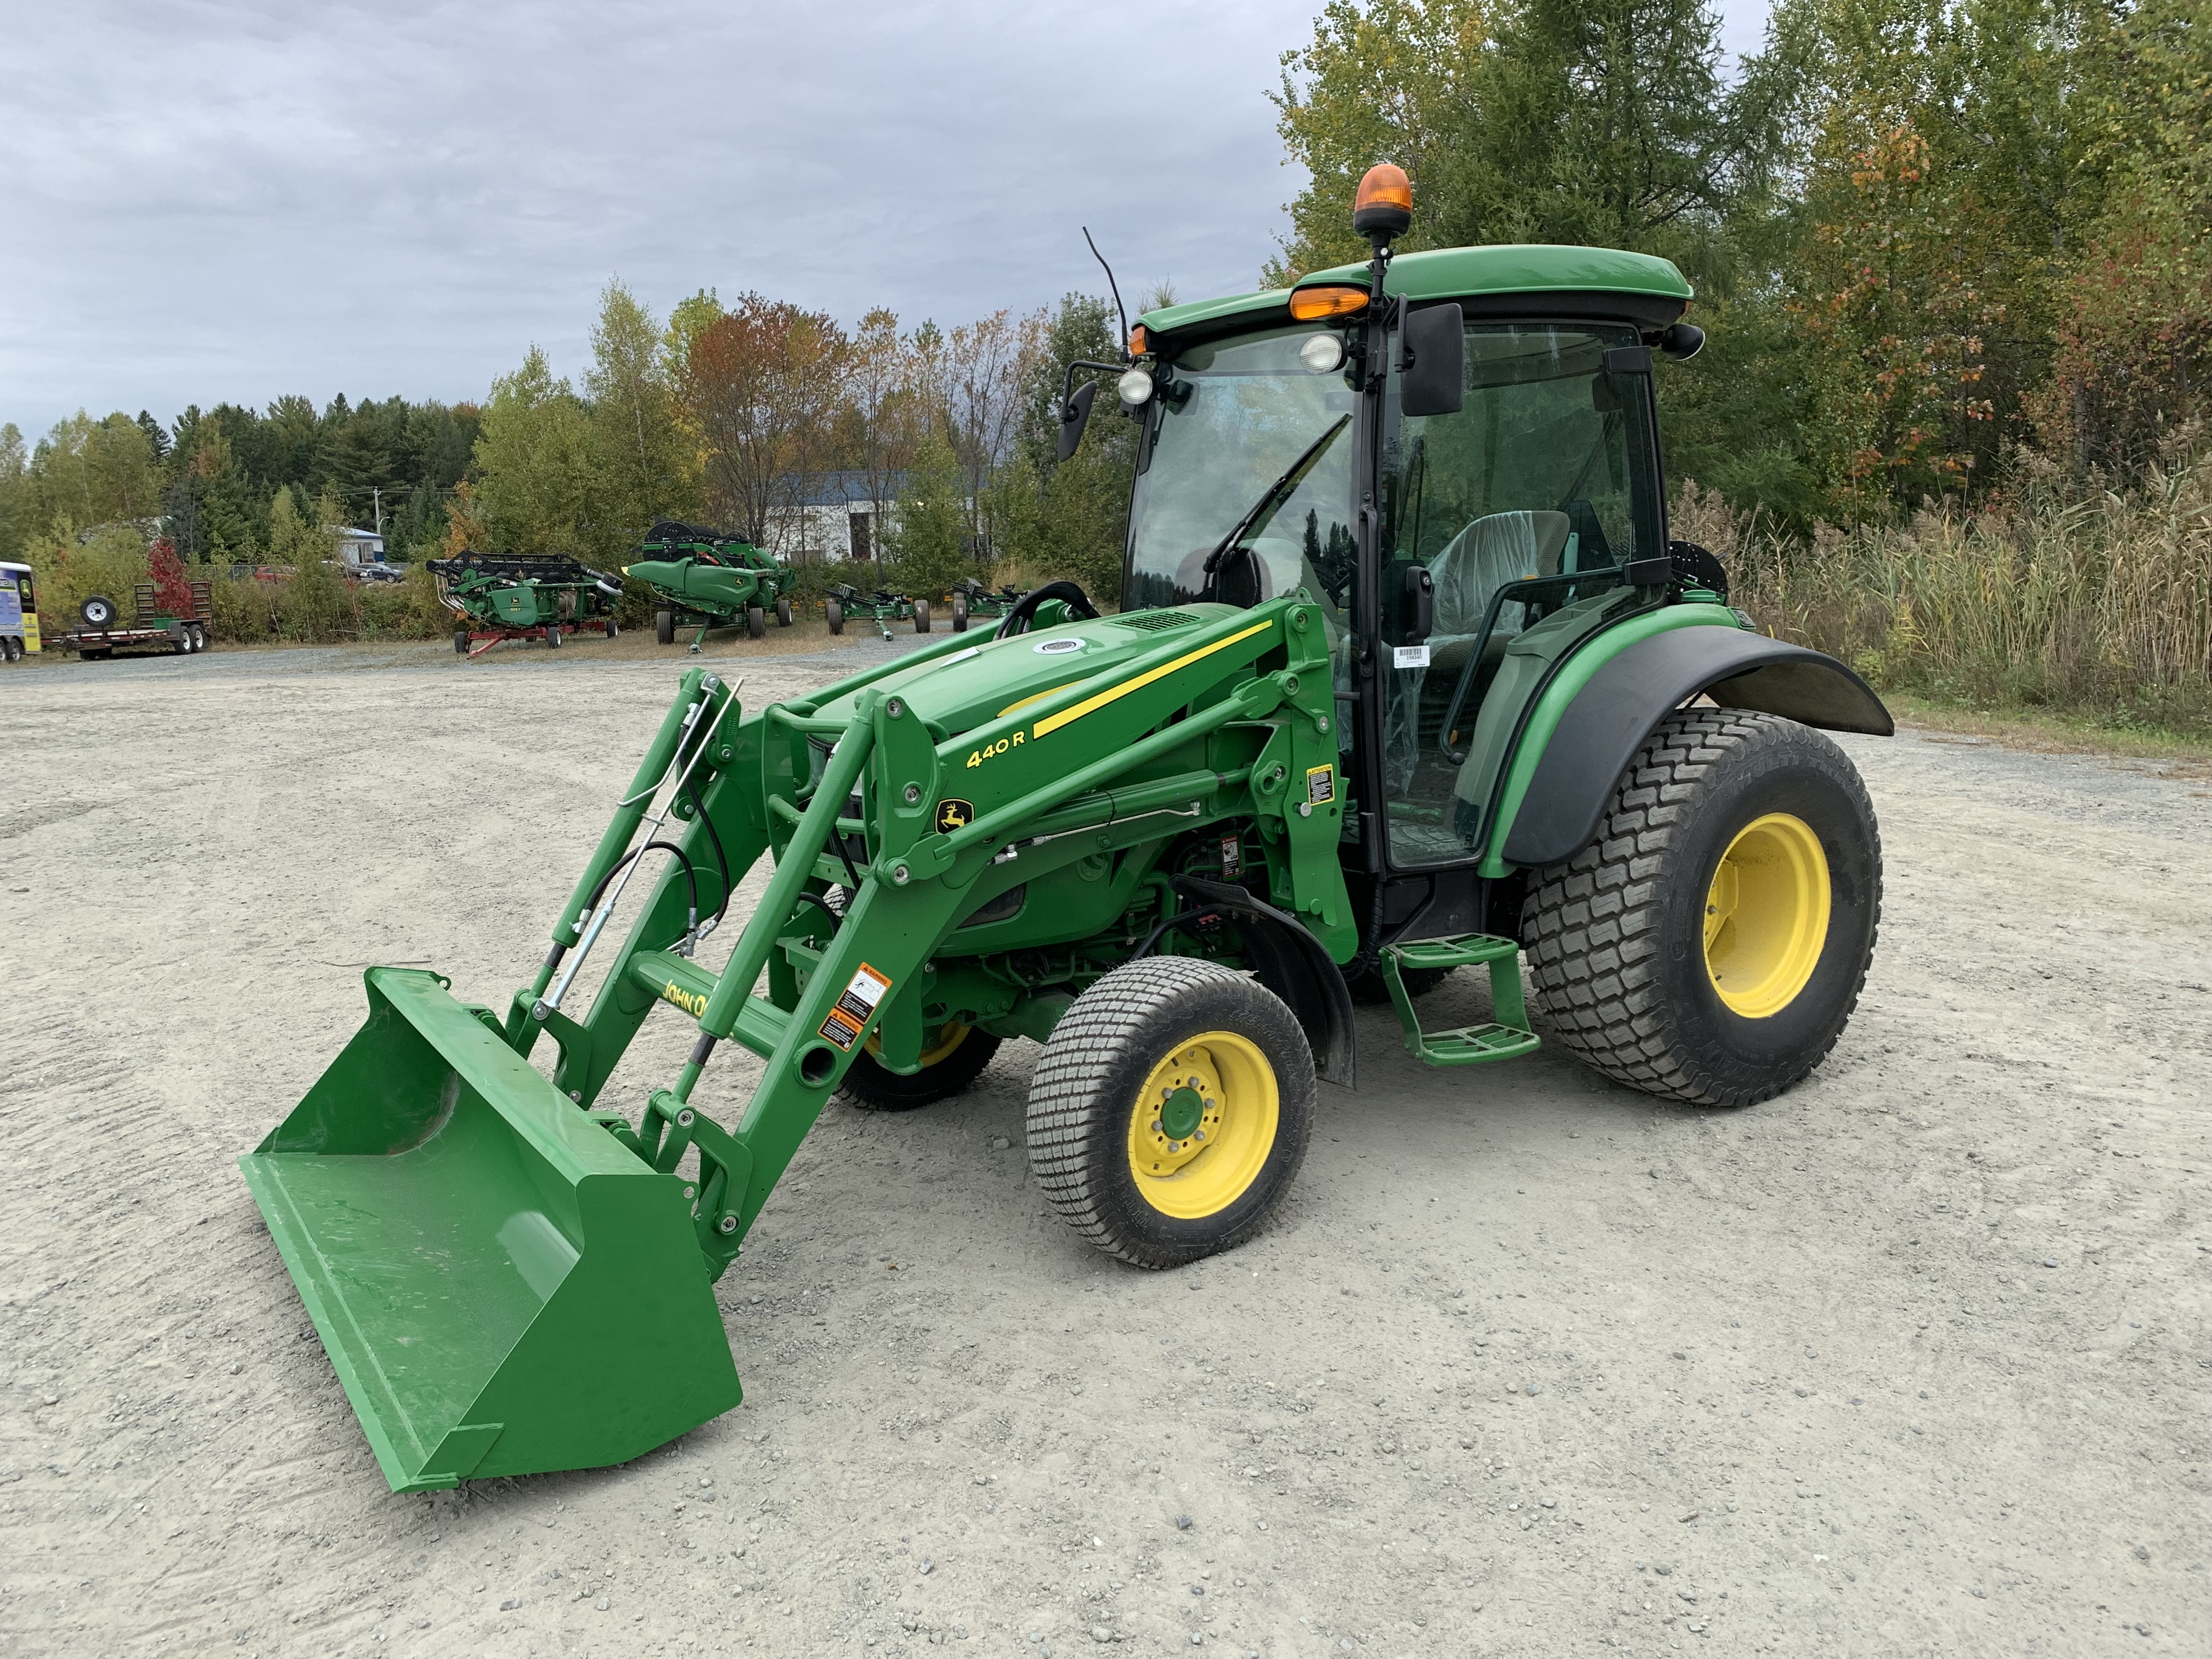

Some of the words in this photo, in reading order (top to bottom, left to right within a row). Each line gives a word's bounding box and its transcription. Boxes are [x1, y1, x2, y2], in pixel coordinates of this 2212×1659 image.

[966, 738, 1009, 769] 440
[1013, 731, 1025, 747] R
[868, 969, 888, 984] WARNING
[662, 979, 695, 1013] JOHN
[839, 1015, 859, 1031] WARNING
